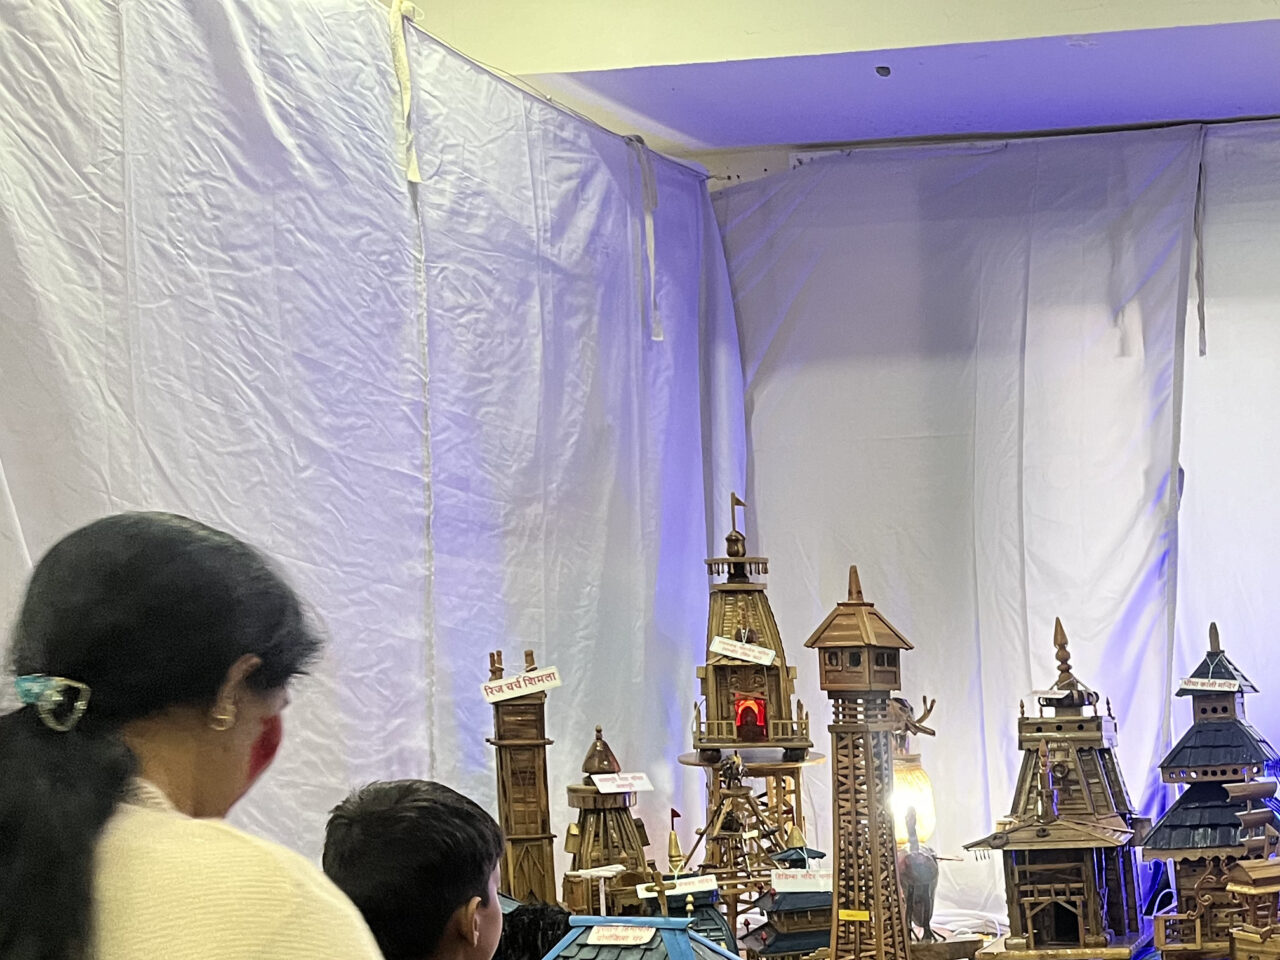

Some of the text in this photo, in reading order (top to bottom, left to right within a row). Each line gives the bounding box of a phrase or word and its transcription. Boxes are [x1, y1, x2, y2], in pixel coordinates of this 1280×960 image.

[484, 672, 557, 697] रिज चर्च शिमला
